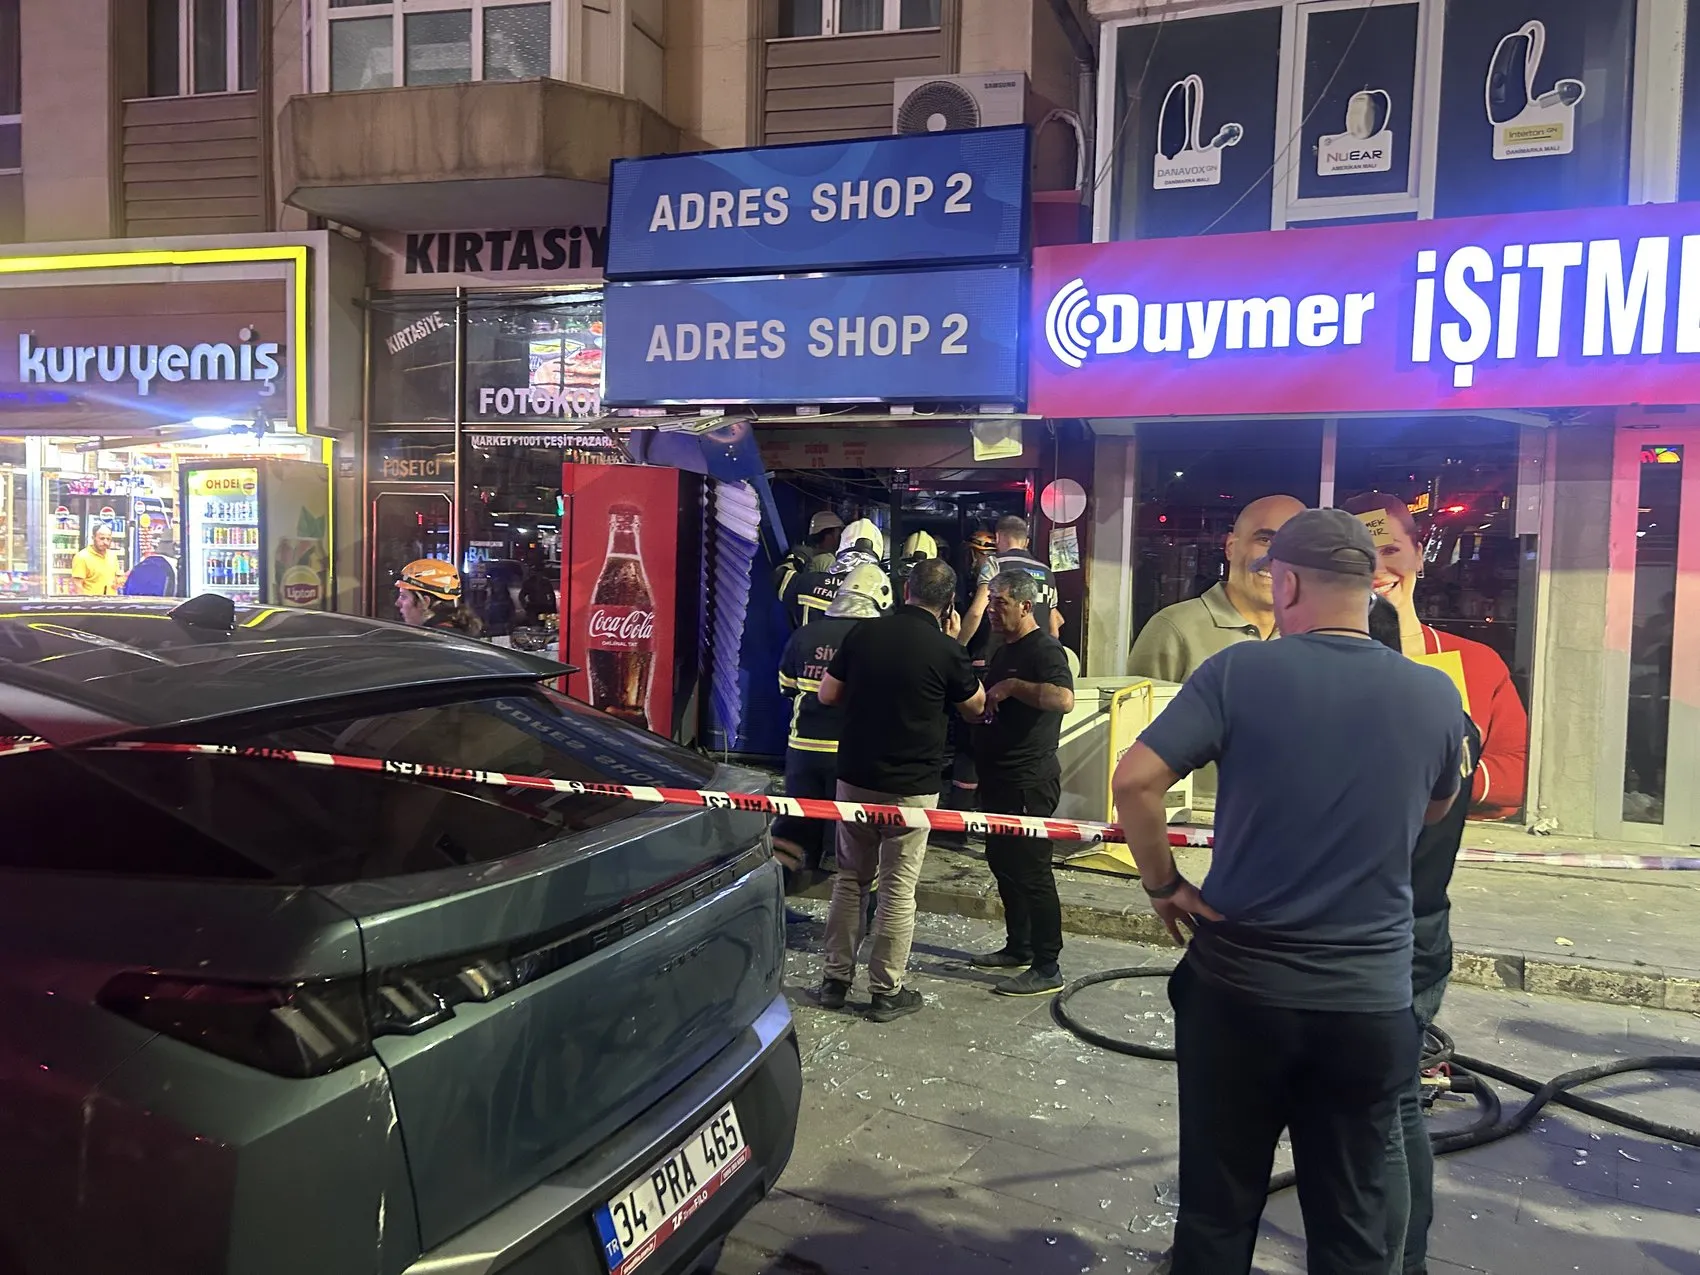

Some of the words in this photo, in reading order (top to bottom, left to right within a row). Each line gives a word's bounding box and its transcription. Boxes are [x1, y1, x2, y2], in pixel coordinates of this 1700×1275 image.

[1157, 166, 1205, 177] DANAVOX
[649, 186, 789, 232] ADRES
[811, 176, 934, 222] SHOP
[944, 172, 972, 214] 2
[645, 319, 786, 362] ADRES
[807, 315, 930, 358] SHOP
[940, 313, 969, 355] 2
[1096, 291, 1375, 360] Duymer
[19, 327, 280, 397] kuruyemiş
[286, 587, 316, 598] Lipton
[589, 609, 656, 639] Coca-Cola
[592, 862, 738, 946] PEUGEOT
[613, 1190, 648, 1248] 34
[651, 1147, 697, 1216] PRA
[700, 1109, 738, 1169] 465
[606, 1238, 620, 1257] TR
